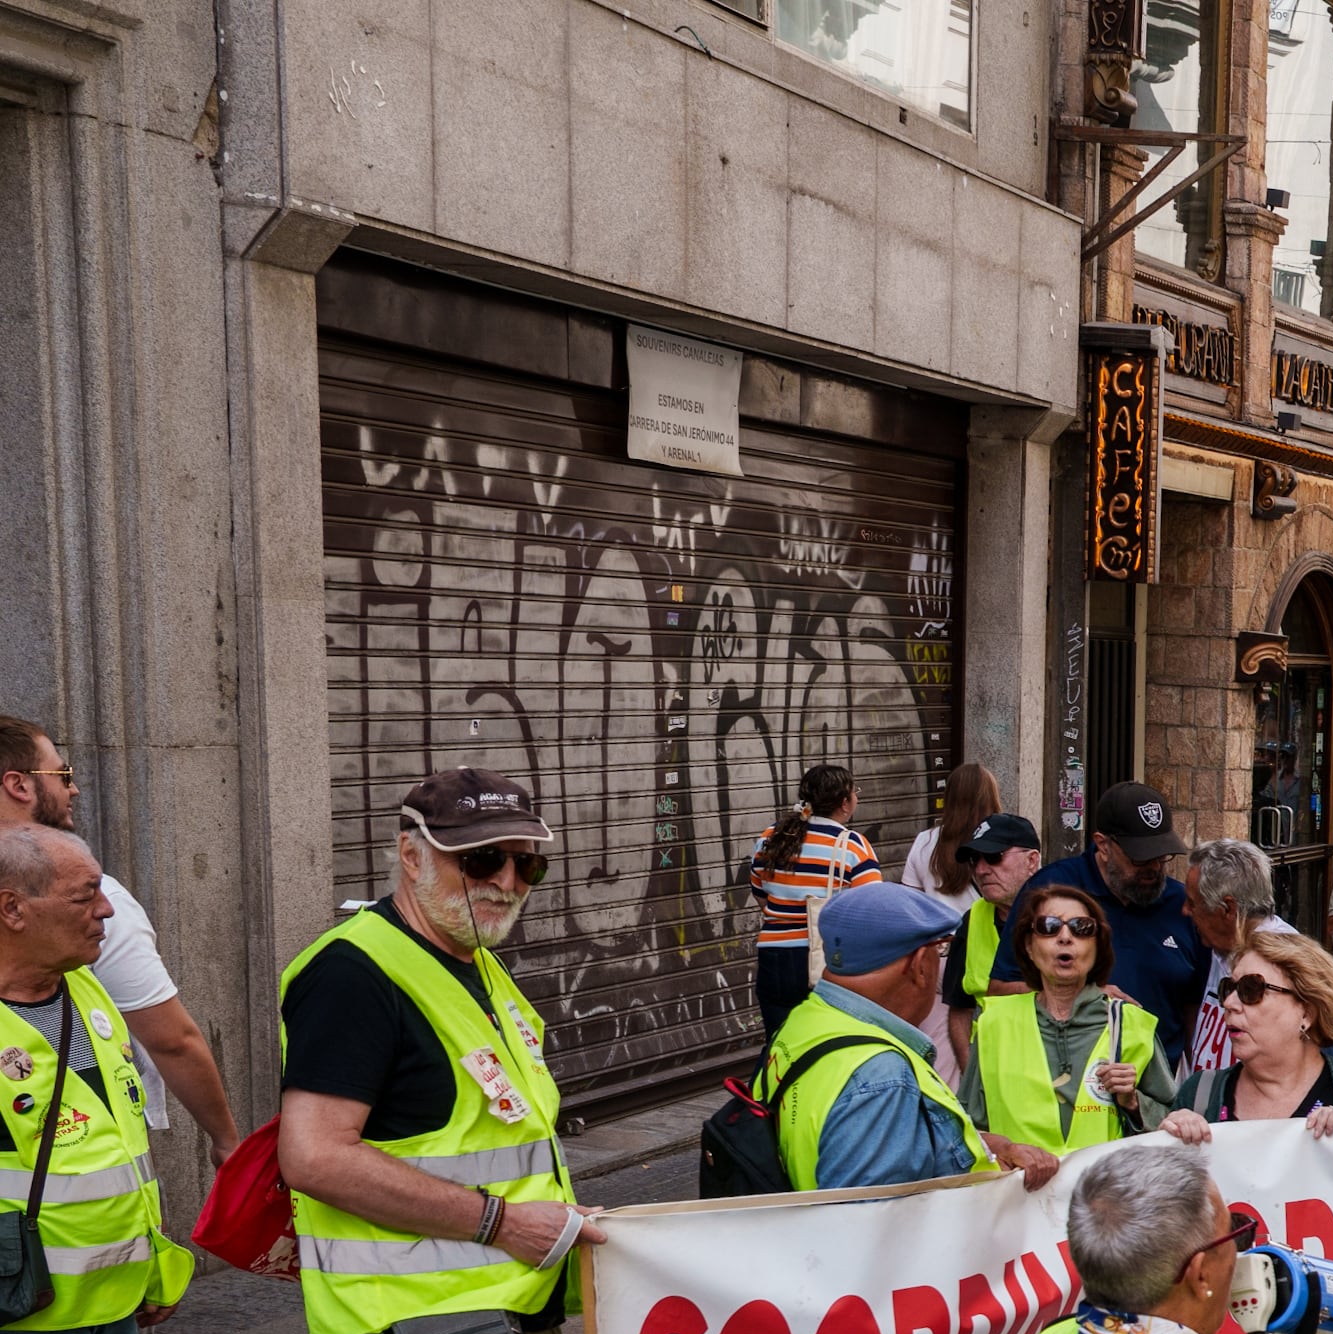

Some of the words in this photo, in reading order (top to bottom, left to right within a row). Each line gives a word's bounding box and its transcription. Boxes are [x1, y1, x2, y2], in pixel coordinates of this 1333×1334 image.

[636, 334, 682, 358] SOUVENIRS
[683, 346, 724, 367] CANALEJAS
[658, 393, 693, 413] ESTAMOS
[694, 402, 705, 415] EN
[630, 414, 660, 432] CARRERA
[661, 421, 672, 435] DE
[672, 423, 688, 438] SAN
[688, 425, 725, 445] JERÓNIMO
[725, 434, 734, 446] 44
[661, 446, 667, 457] Y
[668, 447, 697, 463] ARENAL
